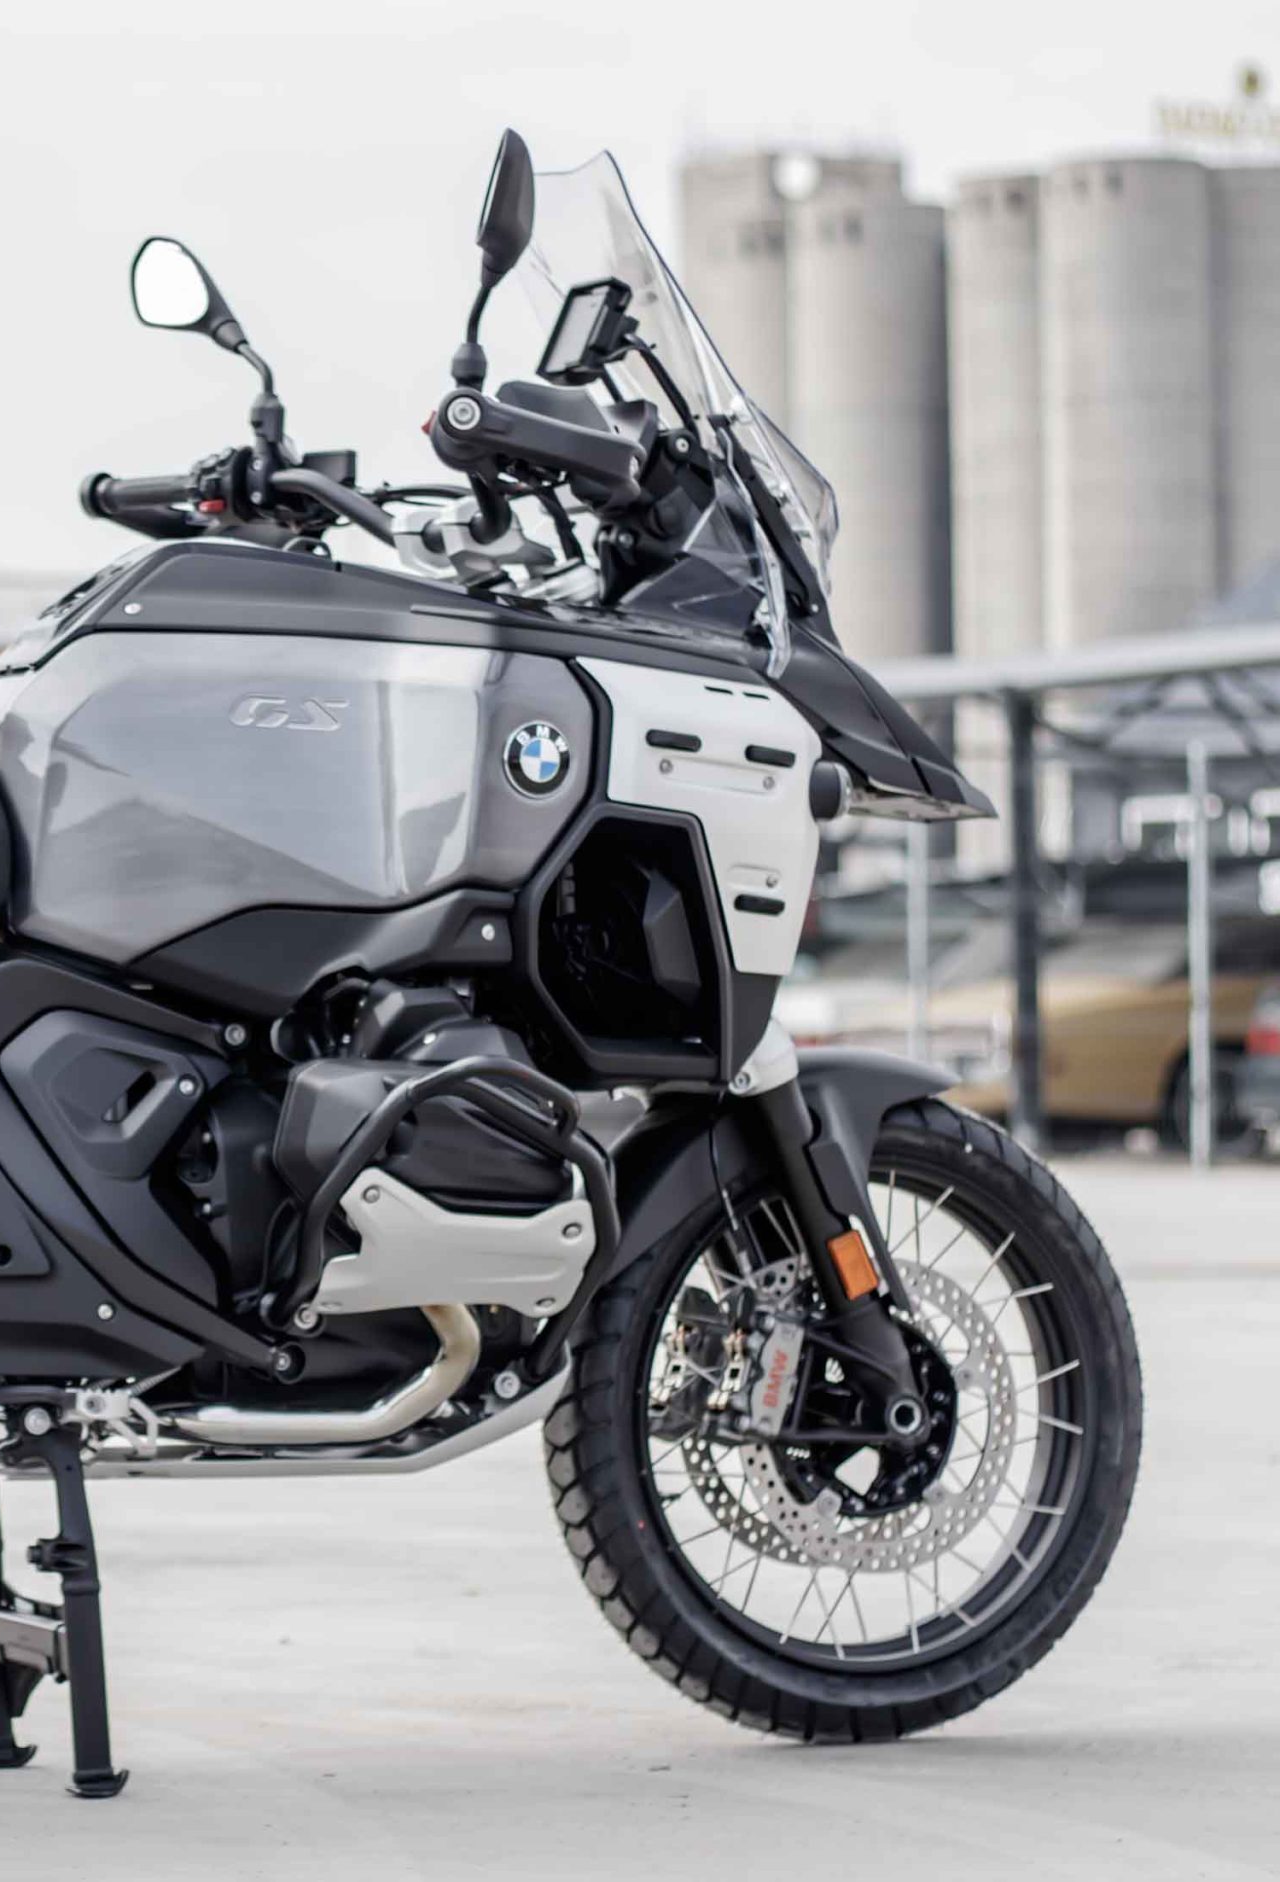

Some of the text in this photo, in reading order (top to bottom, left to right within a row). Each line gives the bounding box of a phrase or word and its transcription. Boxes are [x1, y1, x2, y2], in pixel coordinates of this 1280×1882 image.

[229, 693, 350, 731] GS
[516, 725, 569, 753] BMW
[763, 1348, 789, 1408] BMW
